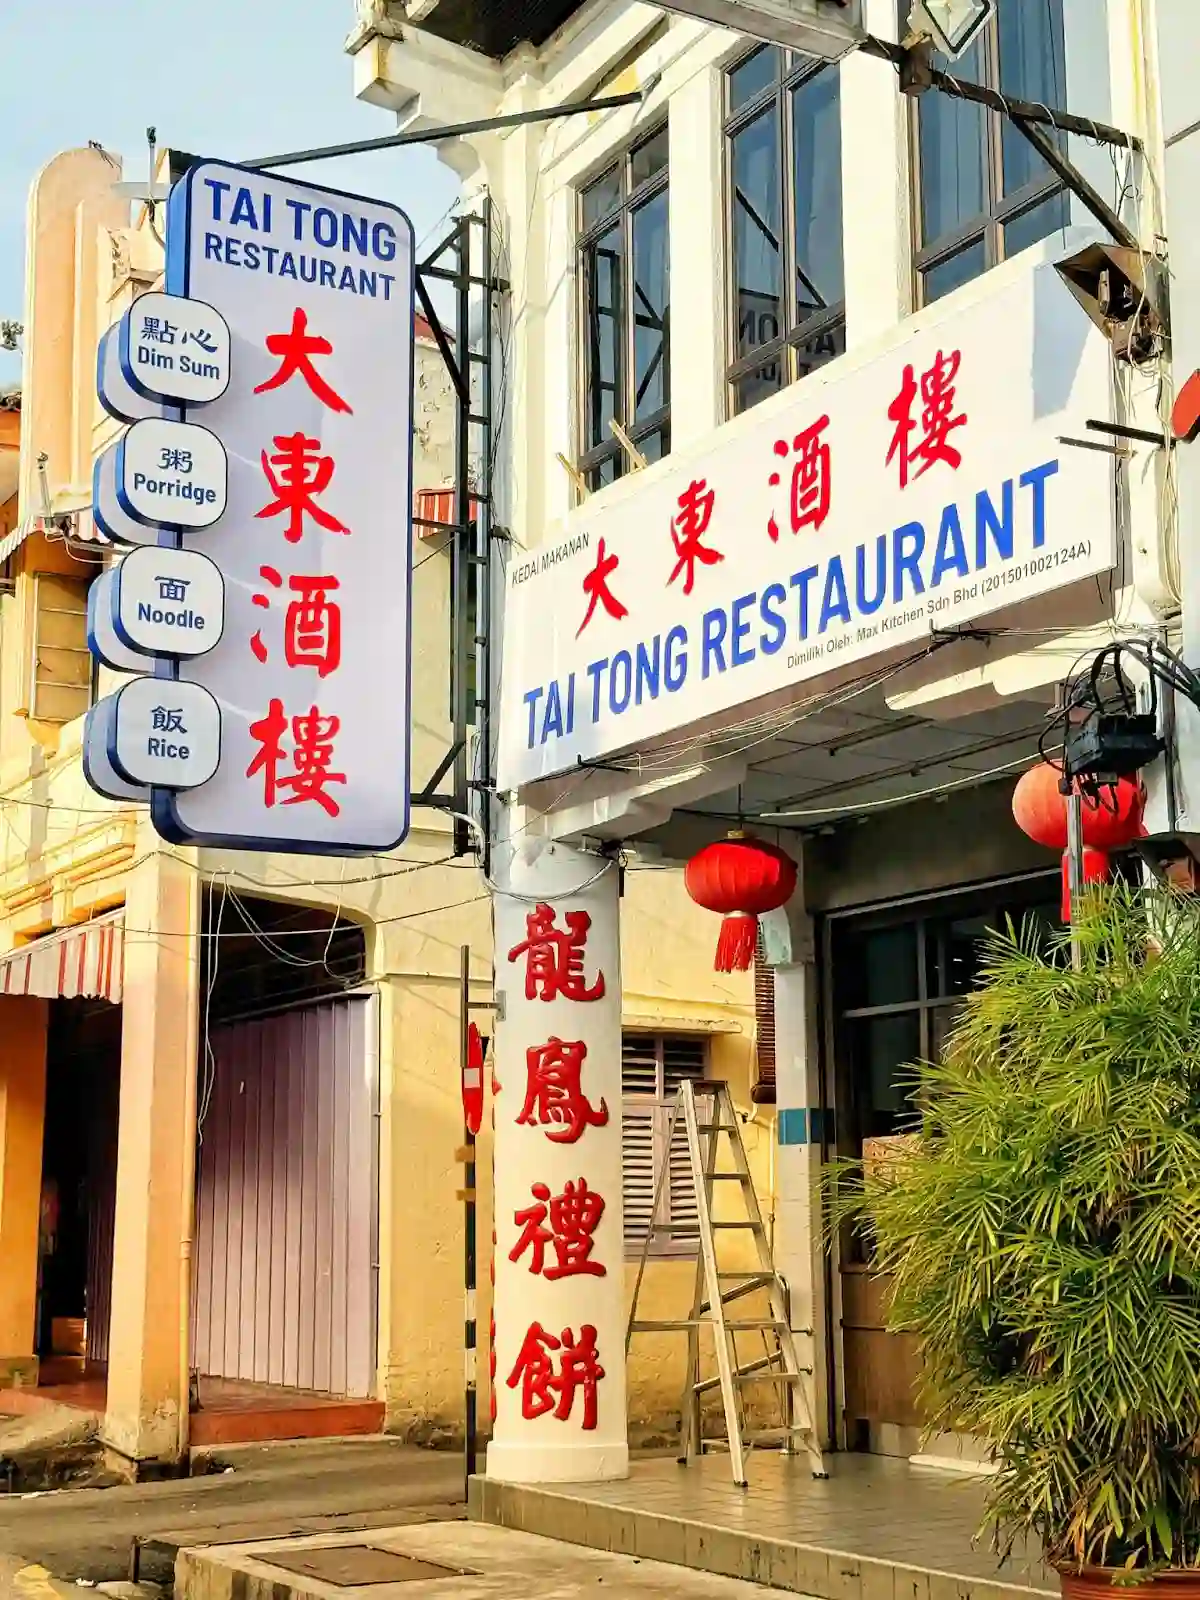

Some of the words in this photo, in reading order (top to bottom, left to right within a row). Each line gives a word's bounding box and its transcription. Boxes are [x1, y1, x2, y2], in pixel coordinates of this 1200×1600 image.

[204, 179, 272, 233] TAI
[286, 199, 397, 262] TONG
[204, 232, 397, 301] RESTAURANT
[141, 316, 219, 353] 點心
[138, 345, 174, 370] Dim
[179, 355, 220, 380] Sum
[157, 447, 194, 474] 粥
[133, 472, 217, 506] Porridge
[575, 349, 968, 640] 大東酒樓
[246, 307, 353, 818] 大東酒樓
[512, 555, 540, 588] KEDAI
[541, 532, 590, 573] MAKANAN
[154, 575, 191, 603] 面
[523, 672, 576, 750] TAI
[586, 624, 688, 725] TONG
[701, 458, 1059, 681] RESTAURANT
[787, 643, 824, 669] Dimiliki
[826, 633, 854, 654] Oleh:
[857, 627, 879, 643] Max
[881, 606, 925, 633] Kitchen
[927, 596, 950, 615] Sdn
[953, 584, 978, 605] Bhd
[981, 539, 1092, 597] (201501002124A)
[138, 602, 205, 630] Noodle
[151, 705, 188, 734] 飯
[147, 737, 190, 760] Rice
[506, 901, 610, 1431] 龍鳳禮餅
